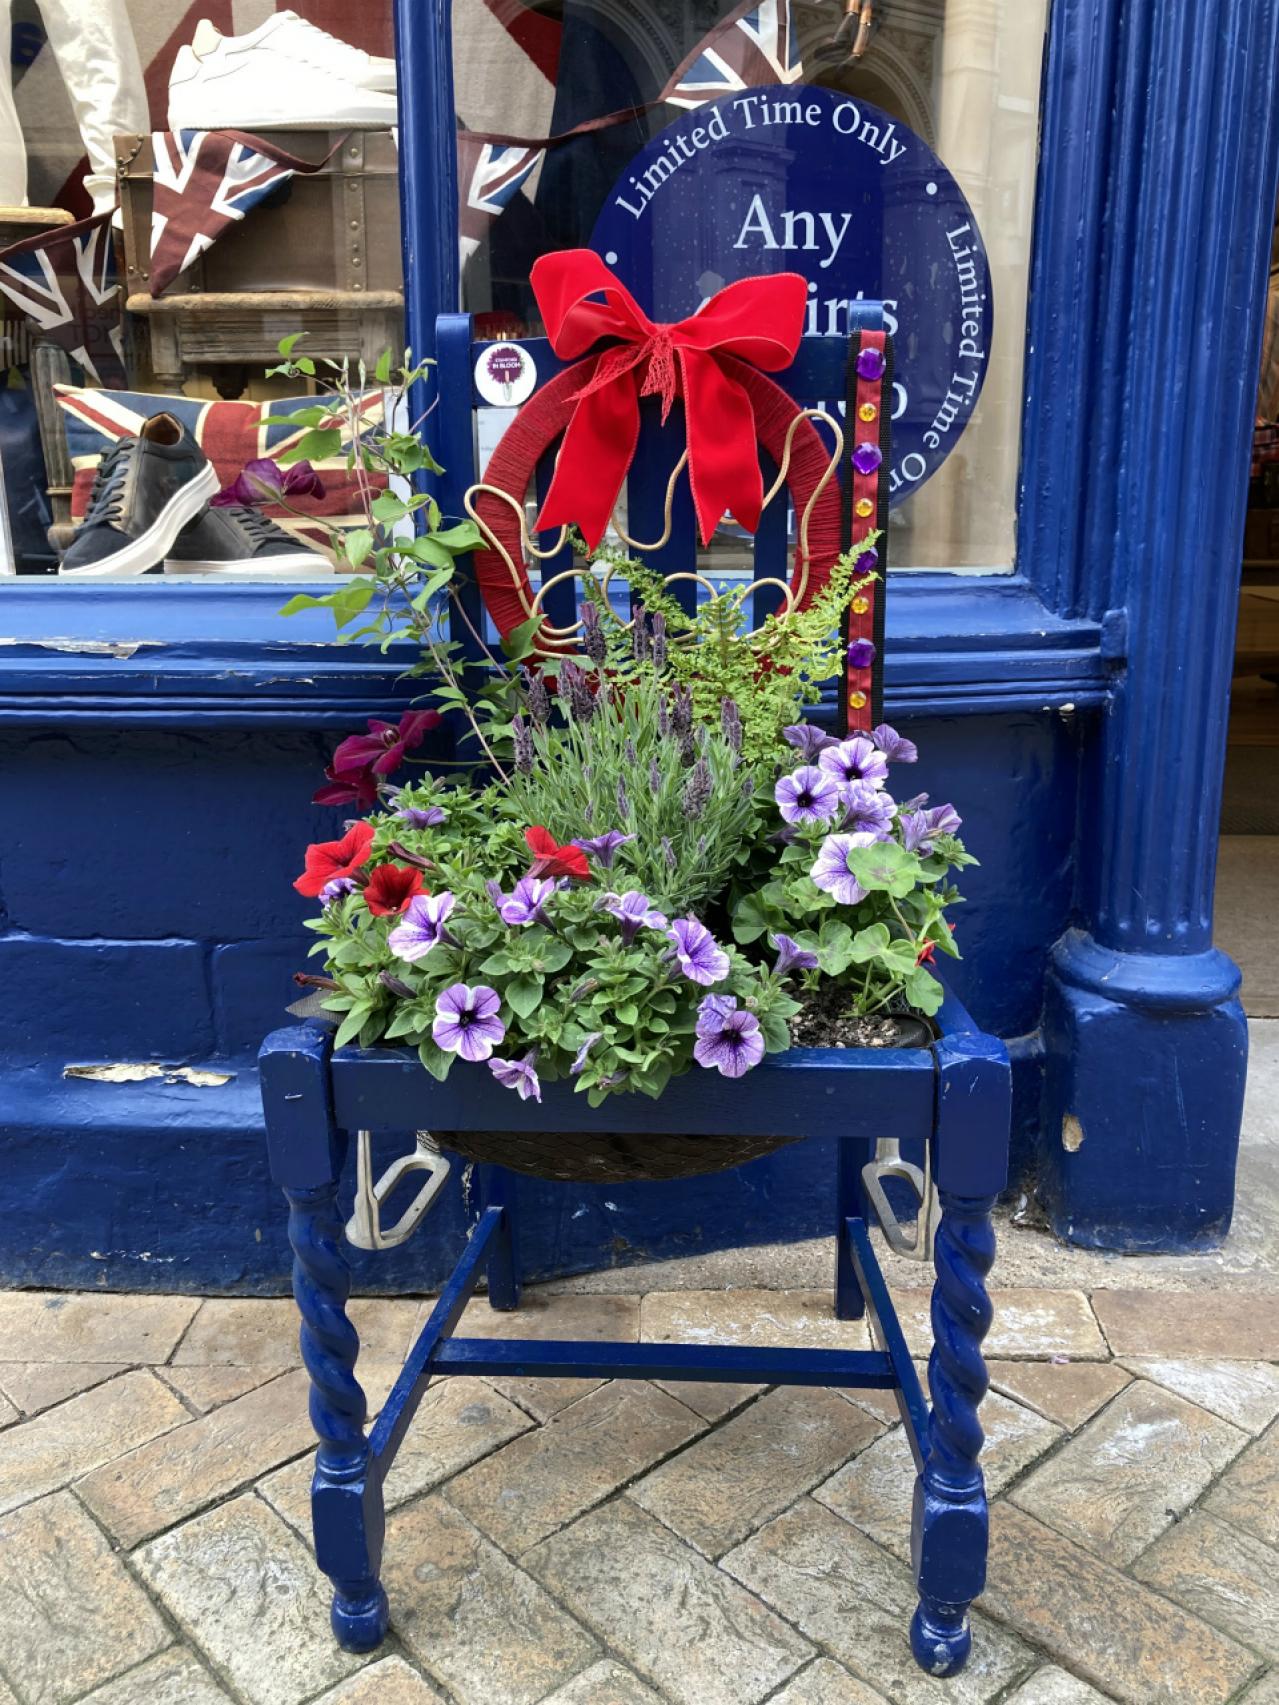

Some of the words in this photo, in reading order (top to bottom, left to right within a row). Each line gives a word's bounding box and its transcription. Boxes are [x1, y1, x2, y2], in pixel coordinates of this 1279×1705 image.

[615, 105, 731, 220] Limited
[733, 94, 822, 129] Time
[833, 103, 907, 165] Only
[733, 194, 852, 268] Any
[946, 222, 986, 359] Limited
[923, 371, 979, 449] Time
[889, 453, 926, 492] On
